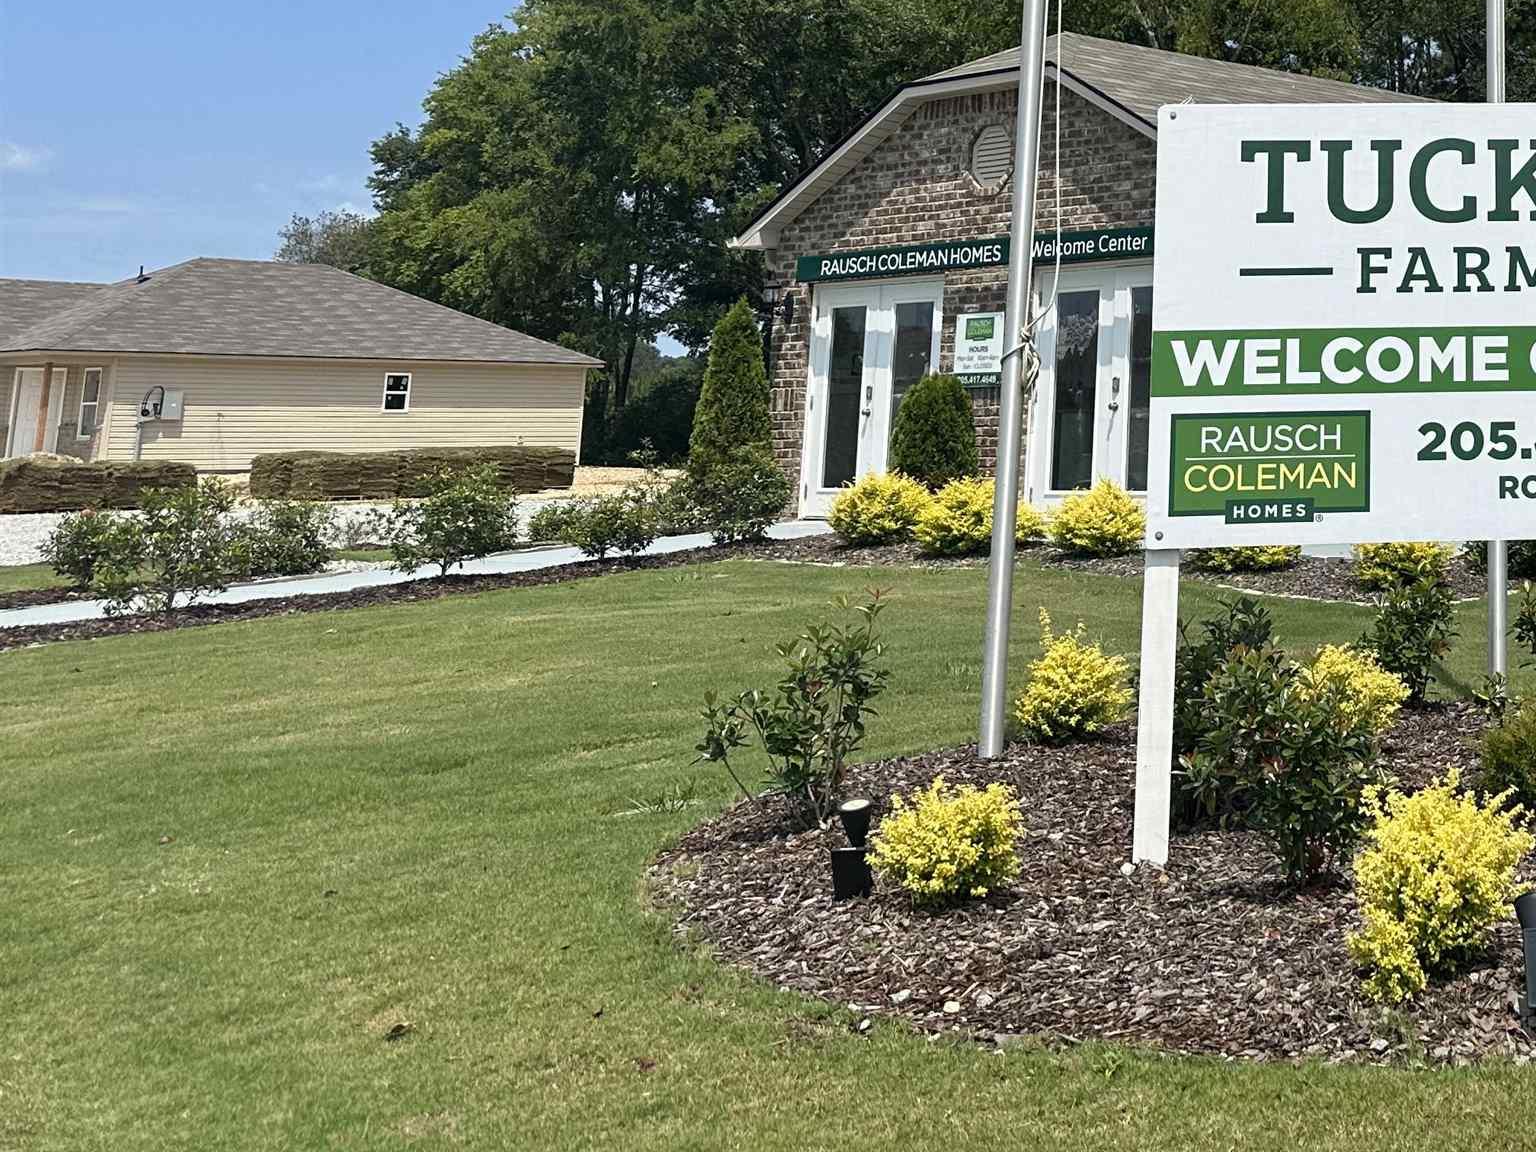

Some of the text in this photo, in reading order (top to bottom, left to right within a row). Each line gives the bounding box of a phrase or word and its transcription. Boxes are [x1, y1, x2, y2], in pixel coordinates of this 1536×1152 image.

[820, 245, 1002, 276] RAUSCH COLEMAN HOMES
[1032, 234, 1148, 258] Welcome Center
[1170, 335, 1510, 387] WELCOME
[1201, 424, 1341, 454] RAUSCH
[1184, 461, 1357, 493] COLEMAN
[1233, 503, 1307, 519] HOMES
